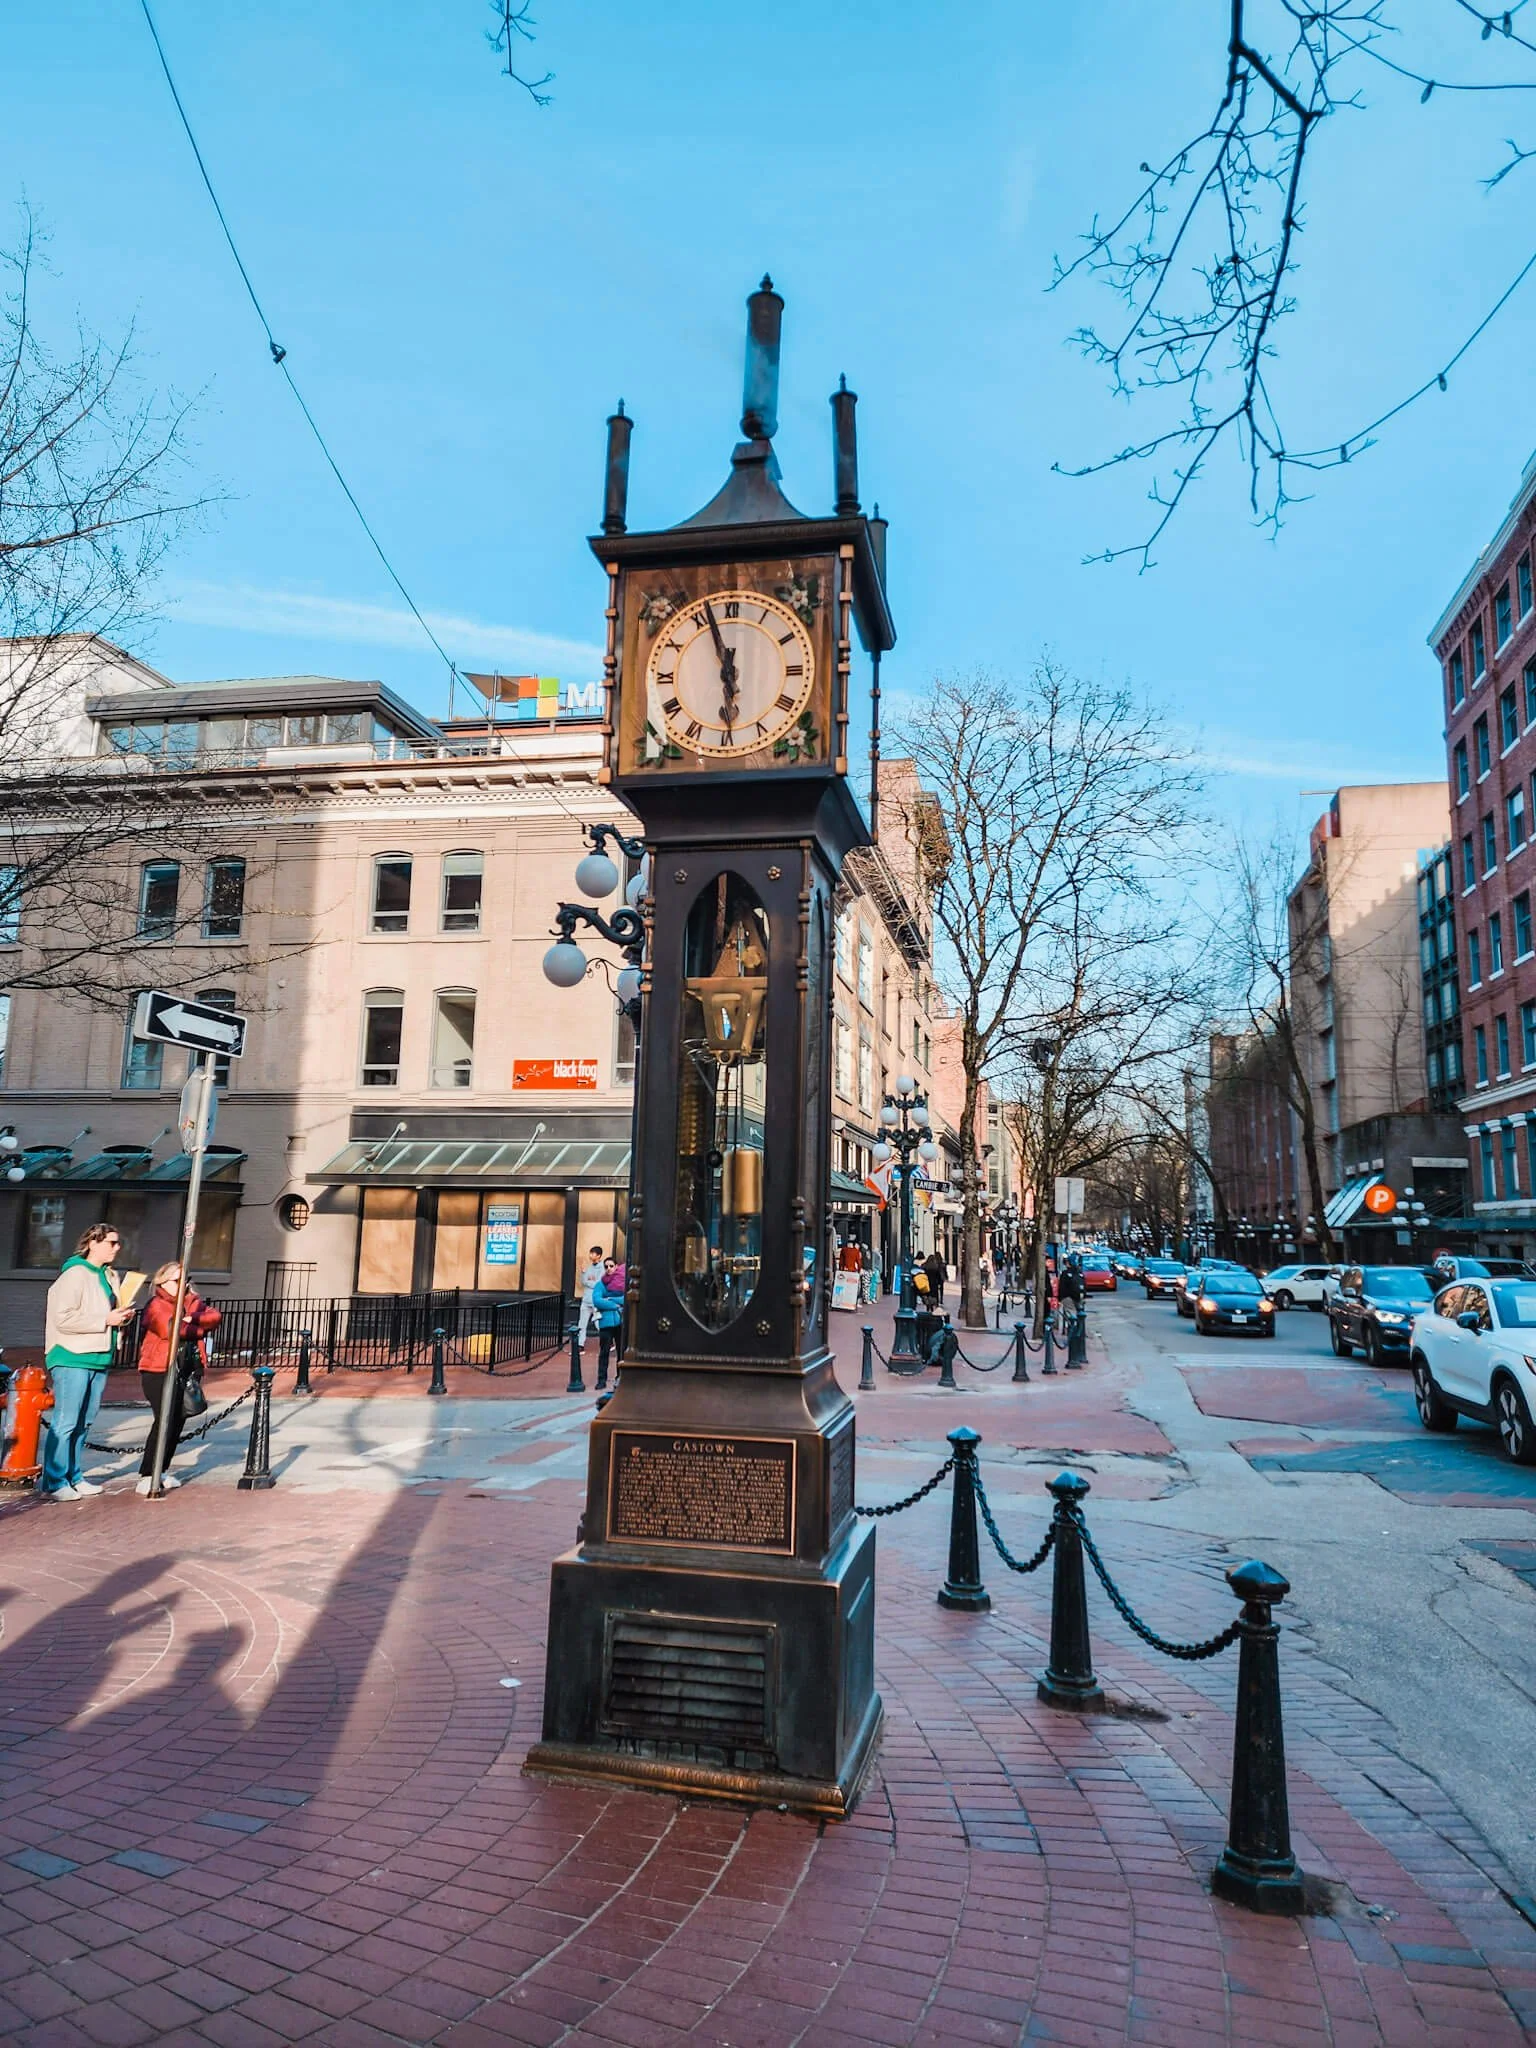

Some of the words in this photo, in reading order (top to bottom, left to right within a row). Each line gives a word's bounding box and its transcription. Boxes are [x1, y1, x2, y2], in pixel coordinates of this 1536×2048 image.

[553, 1060, 577, 1077] black
[578, 1060, 597, 1081] frog
[915, 1180, 938, 1191] CAMBIE
[1373, 1190, 1389, 1208] P
[673, 1440, 735, 1454] GASTOWN
